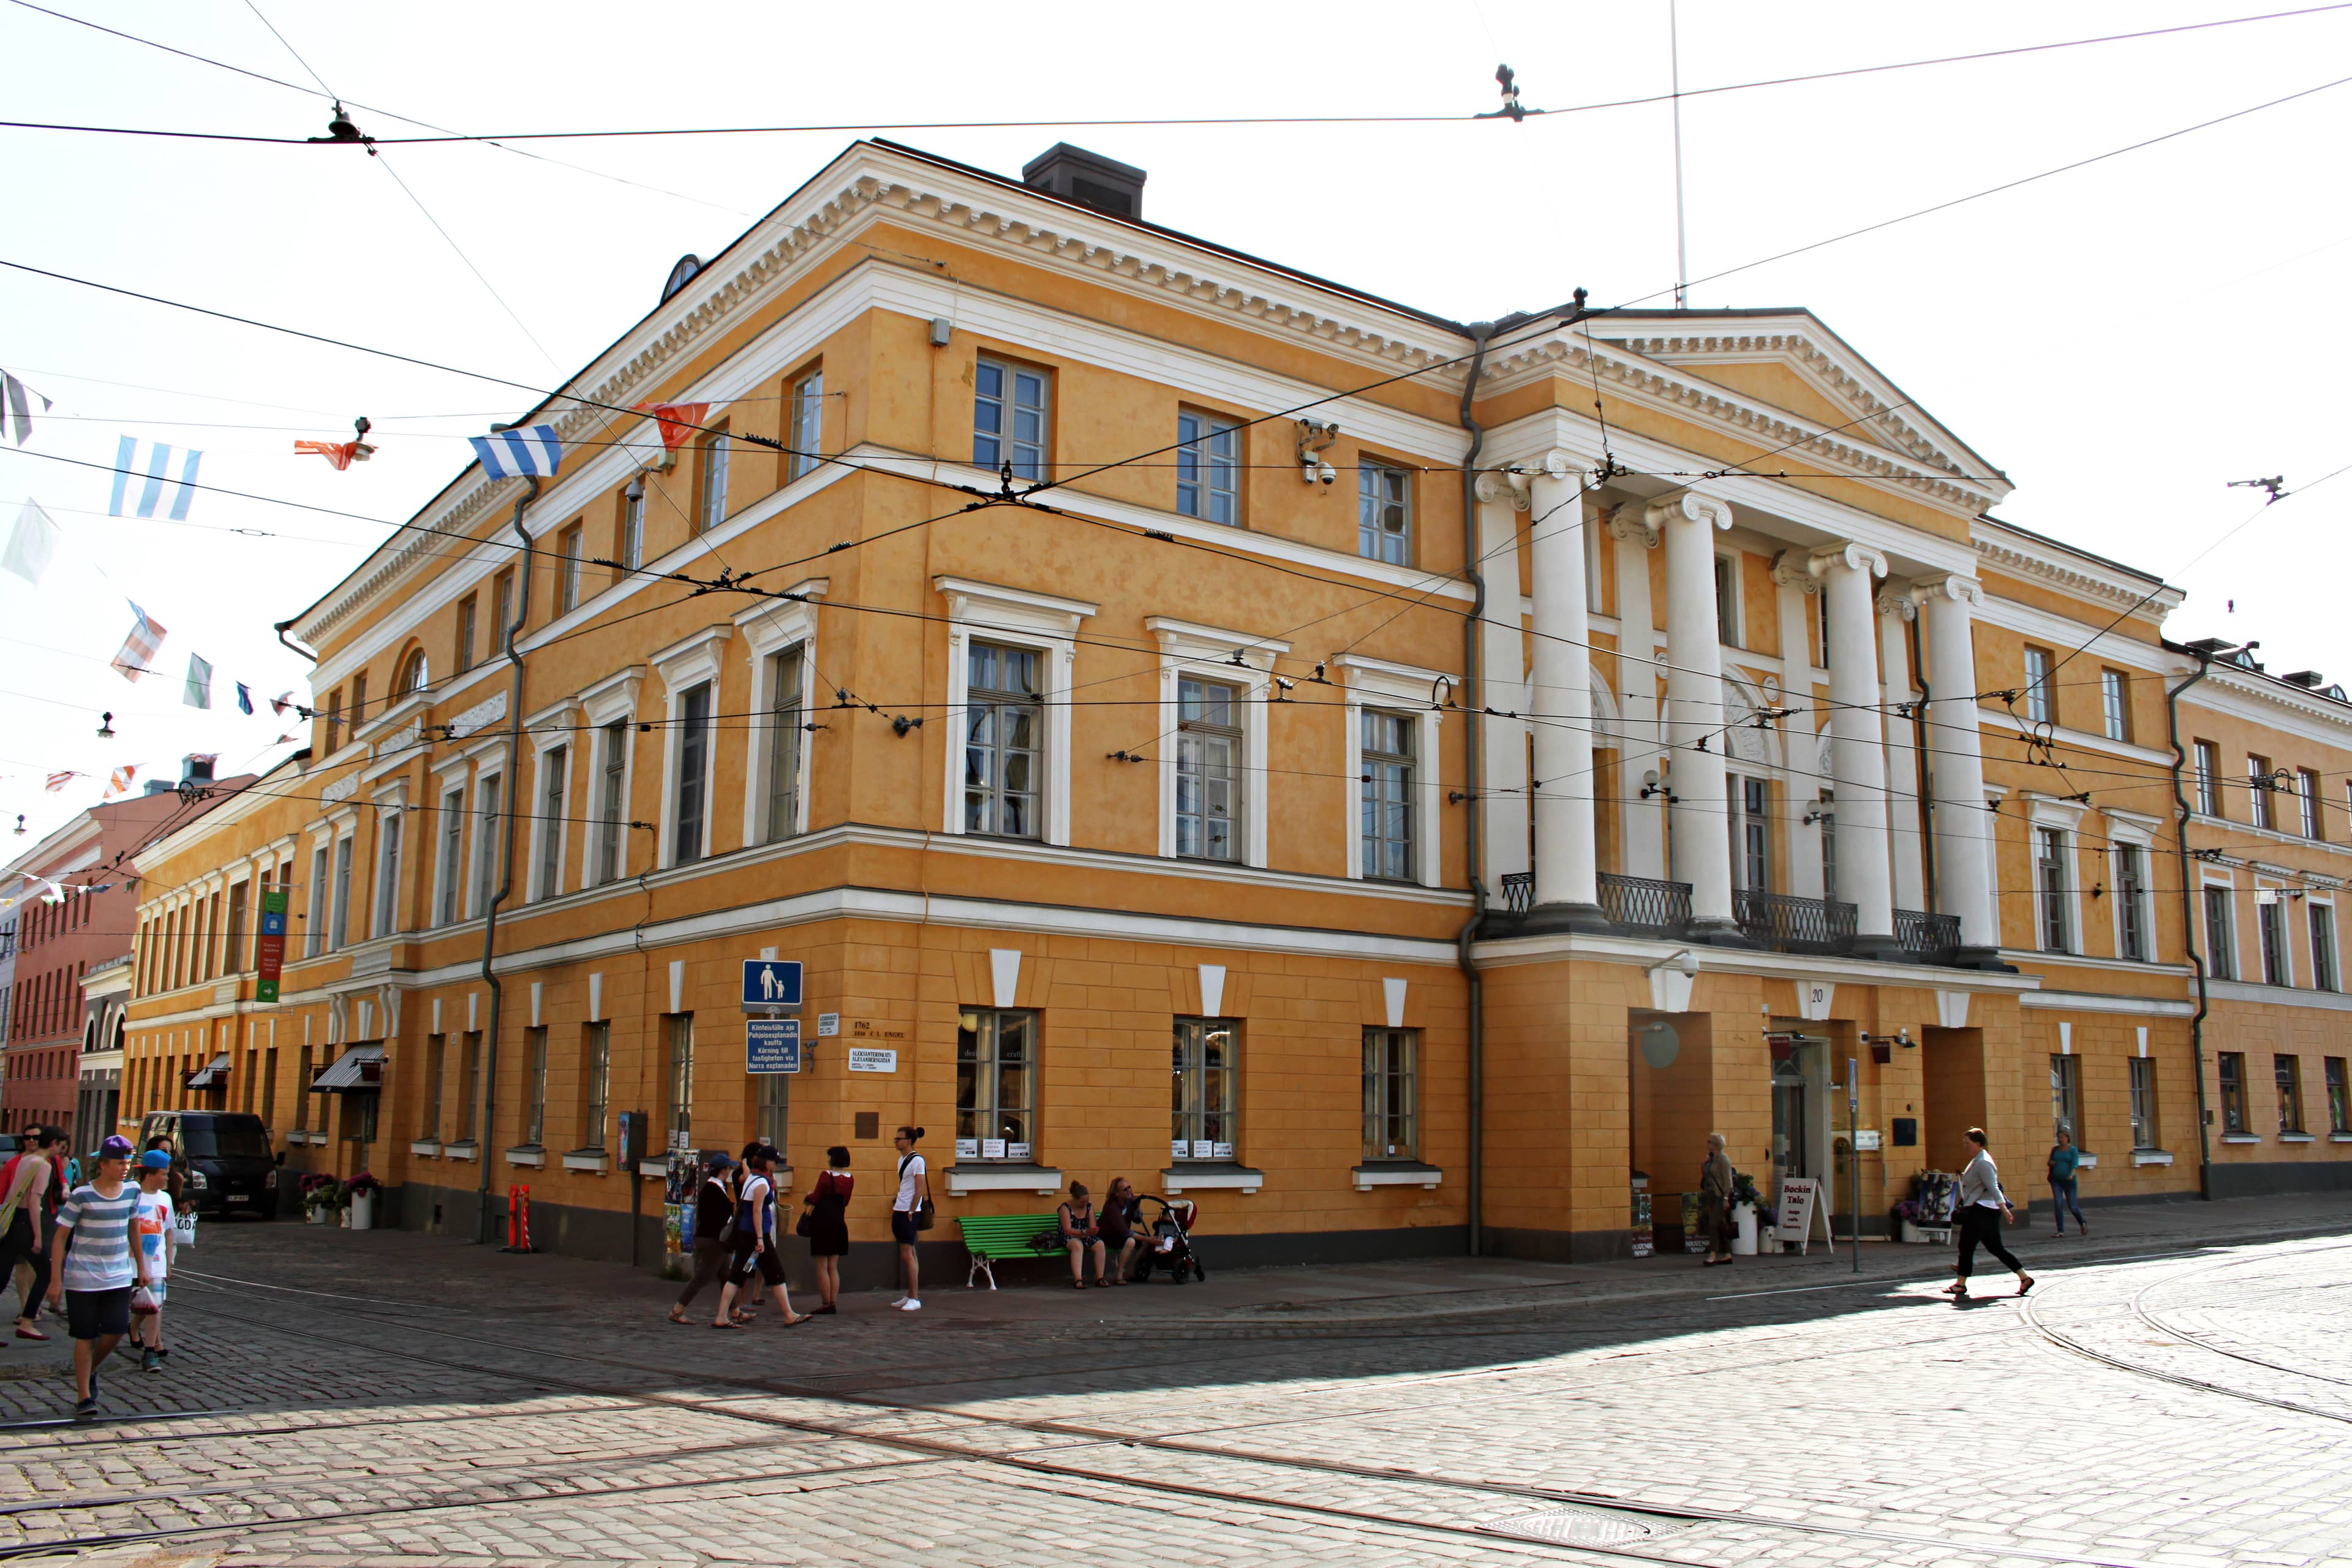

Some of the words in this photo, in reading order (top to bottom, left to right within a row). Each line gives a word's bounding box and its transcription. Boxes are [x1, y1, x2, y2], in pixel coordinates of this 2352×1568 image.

[1812, 989, 1823, 1003] 20
[854, 1021, 870, 1030] 1762
[1787, 1196, 1804, 1204] Talo
